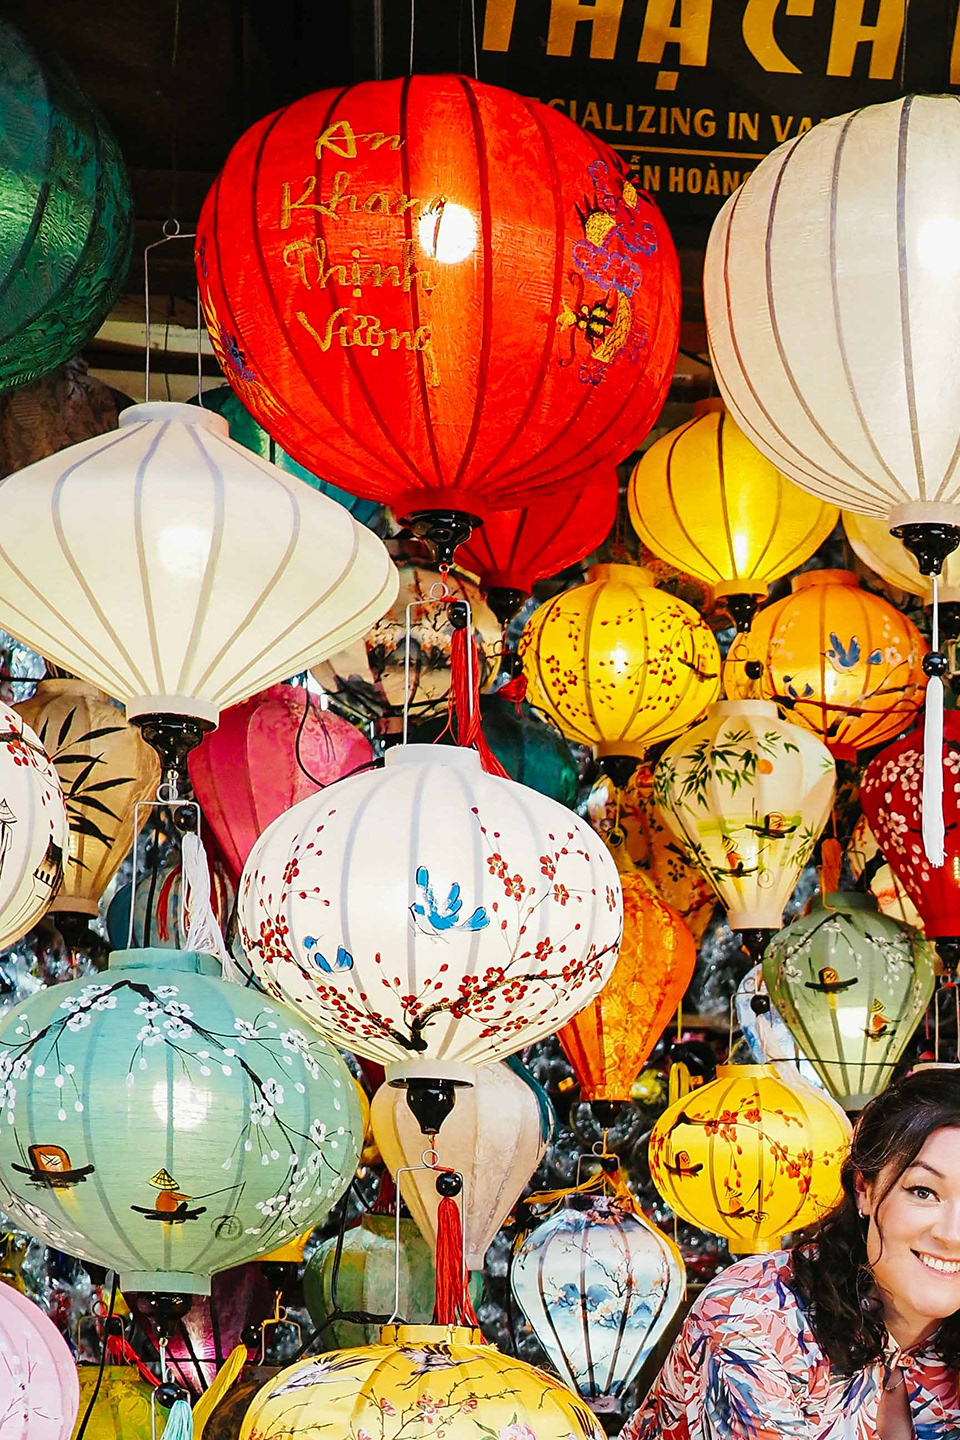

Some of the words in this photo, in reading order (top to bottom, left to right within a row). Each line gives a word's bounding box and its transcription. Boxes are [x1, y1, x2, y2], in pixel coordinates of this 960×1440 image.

[315, 120, 406, 160] An
[530, 97, 715, 138] IALIZING
[728, 112, 760, 142] IN
[280, 171, 448, 259] Khang
[283, 238, 438, 298] Thịnh
[295, 307, 440, 387] Vượng
